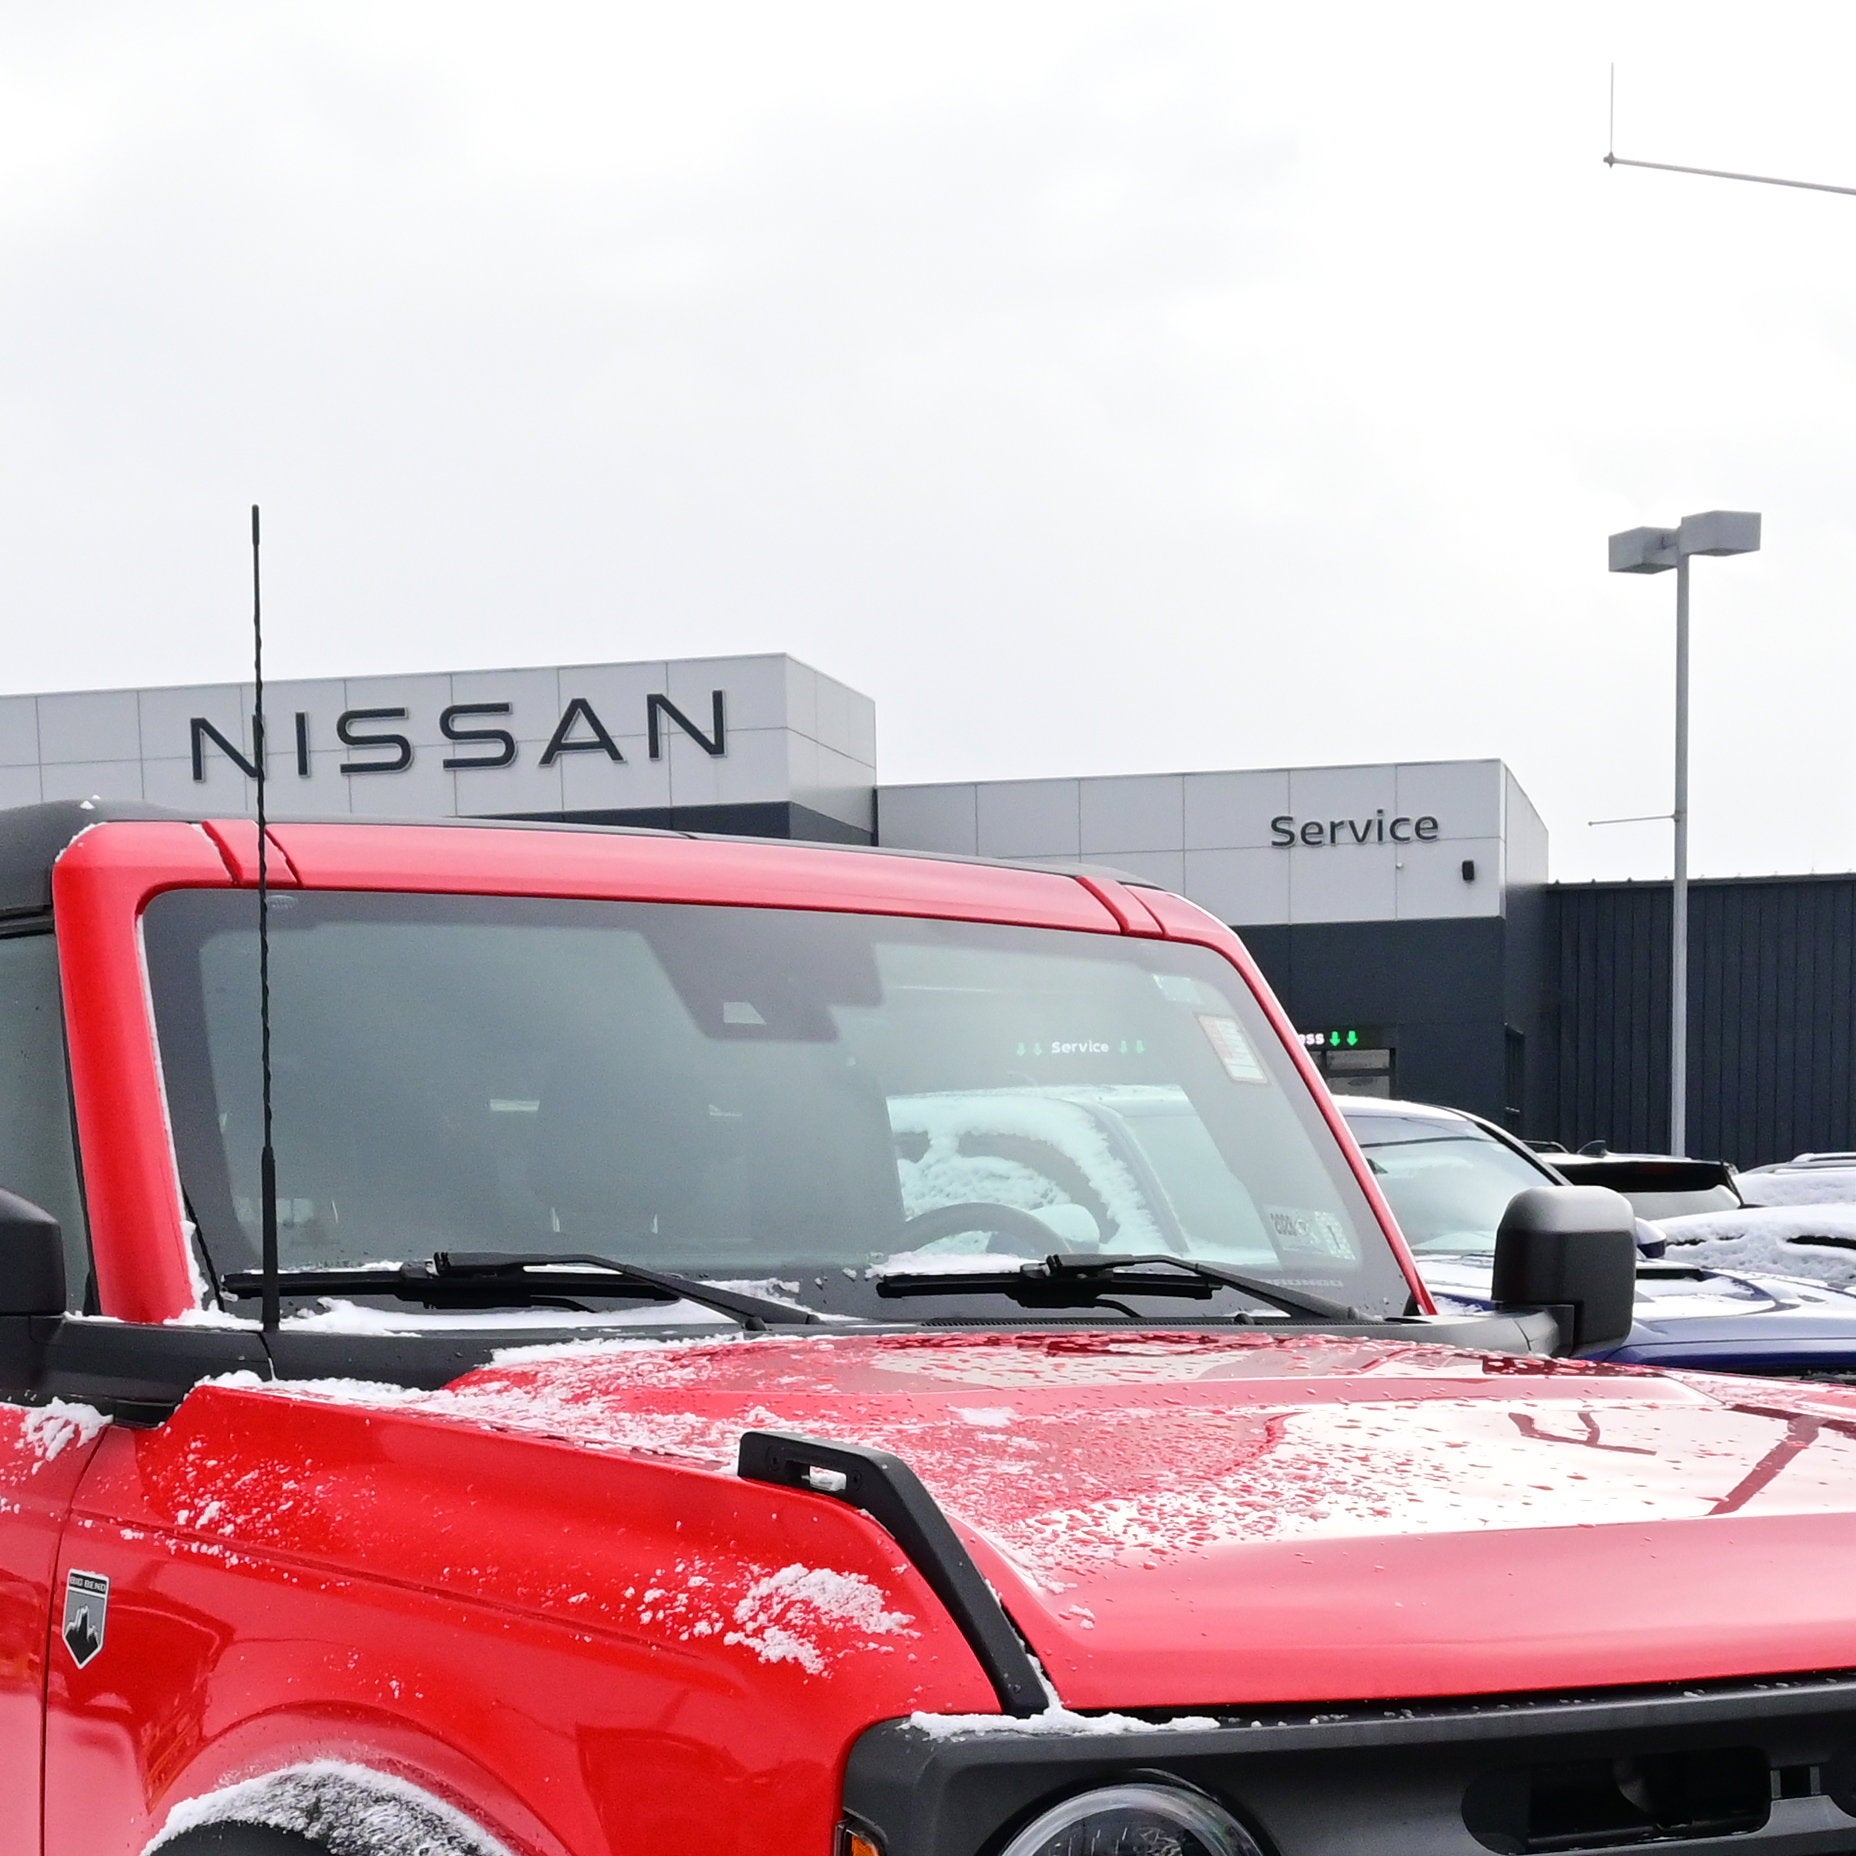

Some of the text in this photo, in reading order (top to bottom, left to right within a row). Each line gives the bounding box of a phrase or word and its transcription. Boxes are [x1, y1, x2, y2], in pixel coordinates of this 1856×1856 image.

[190, 690, 727, 782] NISSAN
[1270, 809, 1440, 848] Service
[1051, 1040, 1109, 1053] Service
